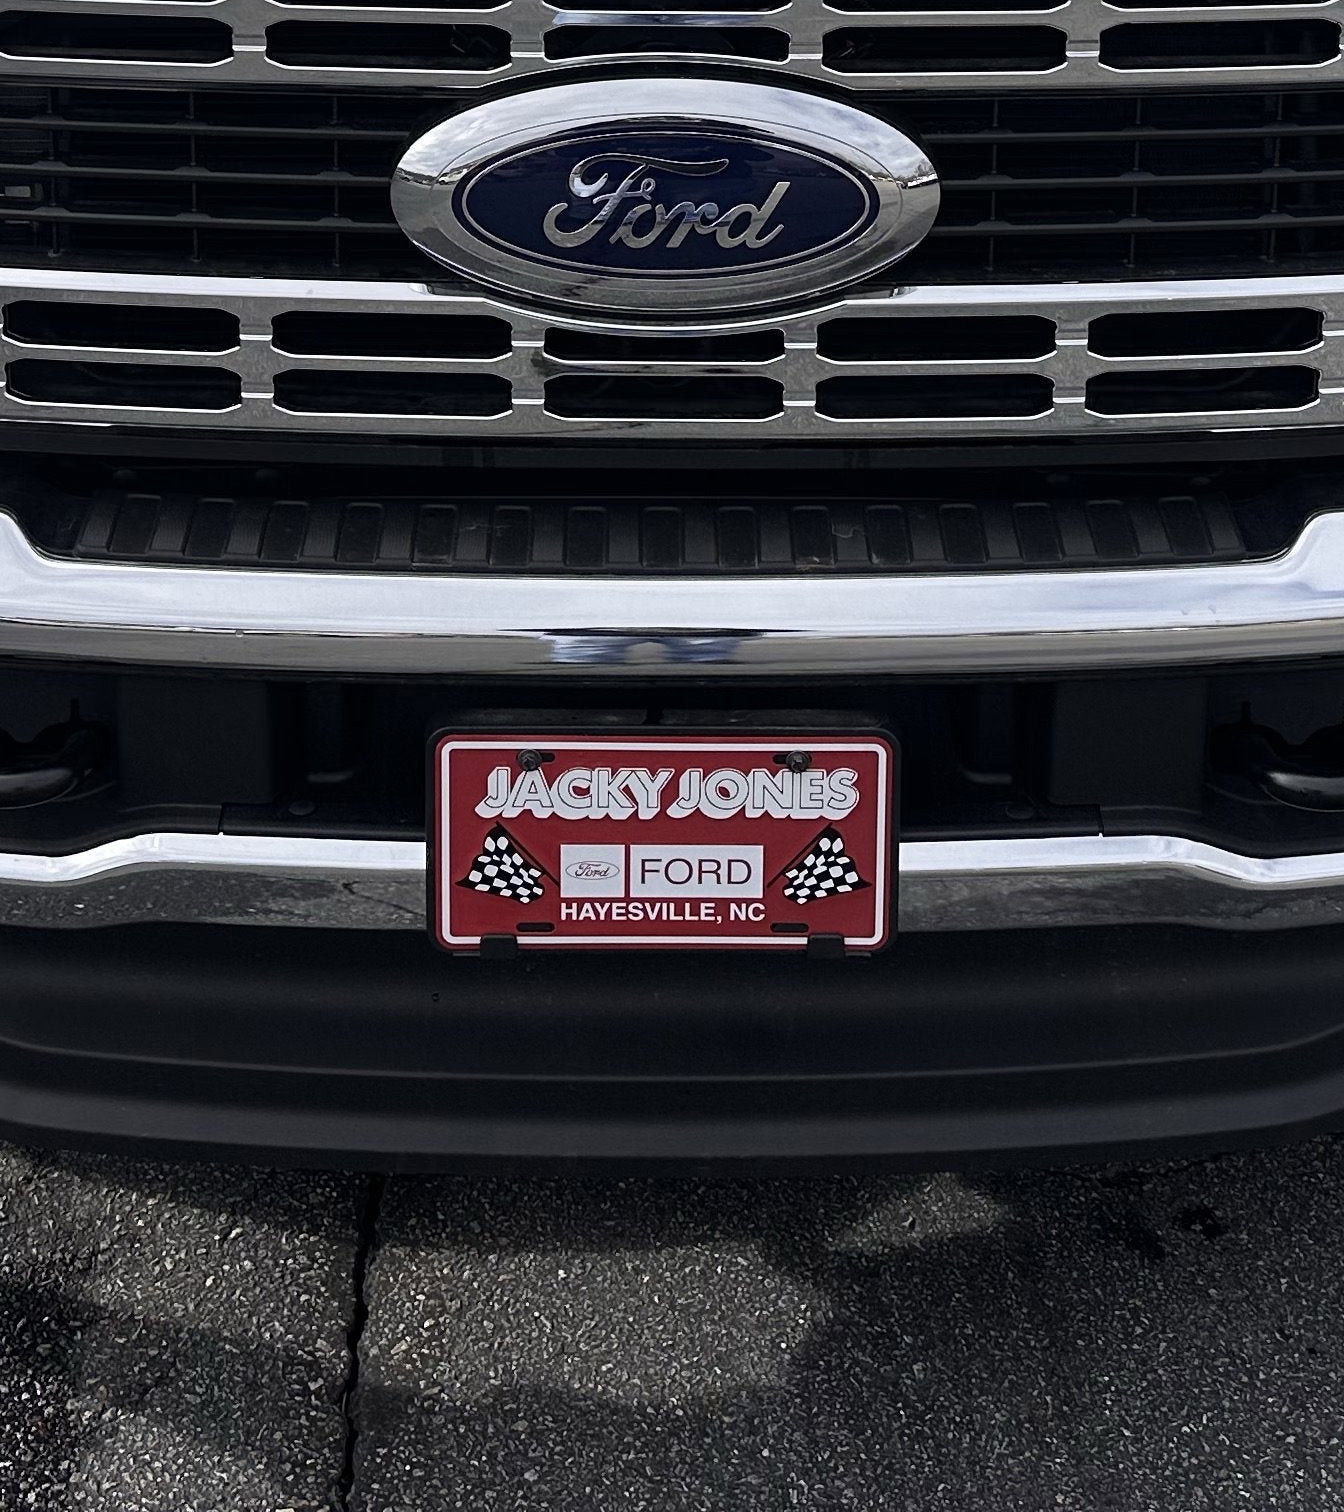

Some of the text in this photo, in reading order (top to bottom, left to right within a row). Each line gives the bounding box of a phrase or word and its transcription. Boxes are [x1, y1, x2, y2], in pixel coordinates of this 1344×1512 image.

[542, 152, 792, 249] Ford
[474, 766, 861, 821] JACKY JONES
[573, 859, 753, 885] Ford FORD
[560, 903, 766, 924] HAYESVILLE, NC
